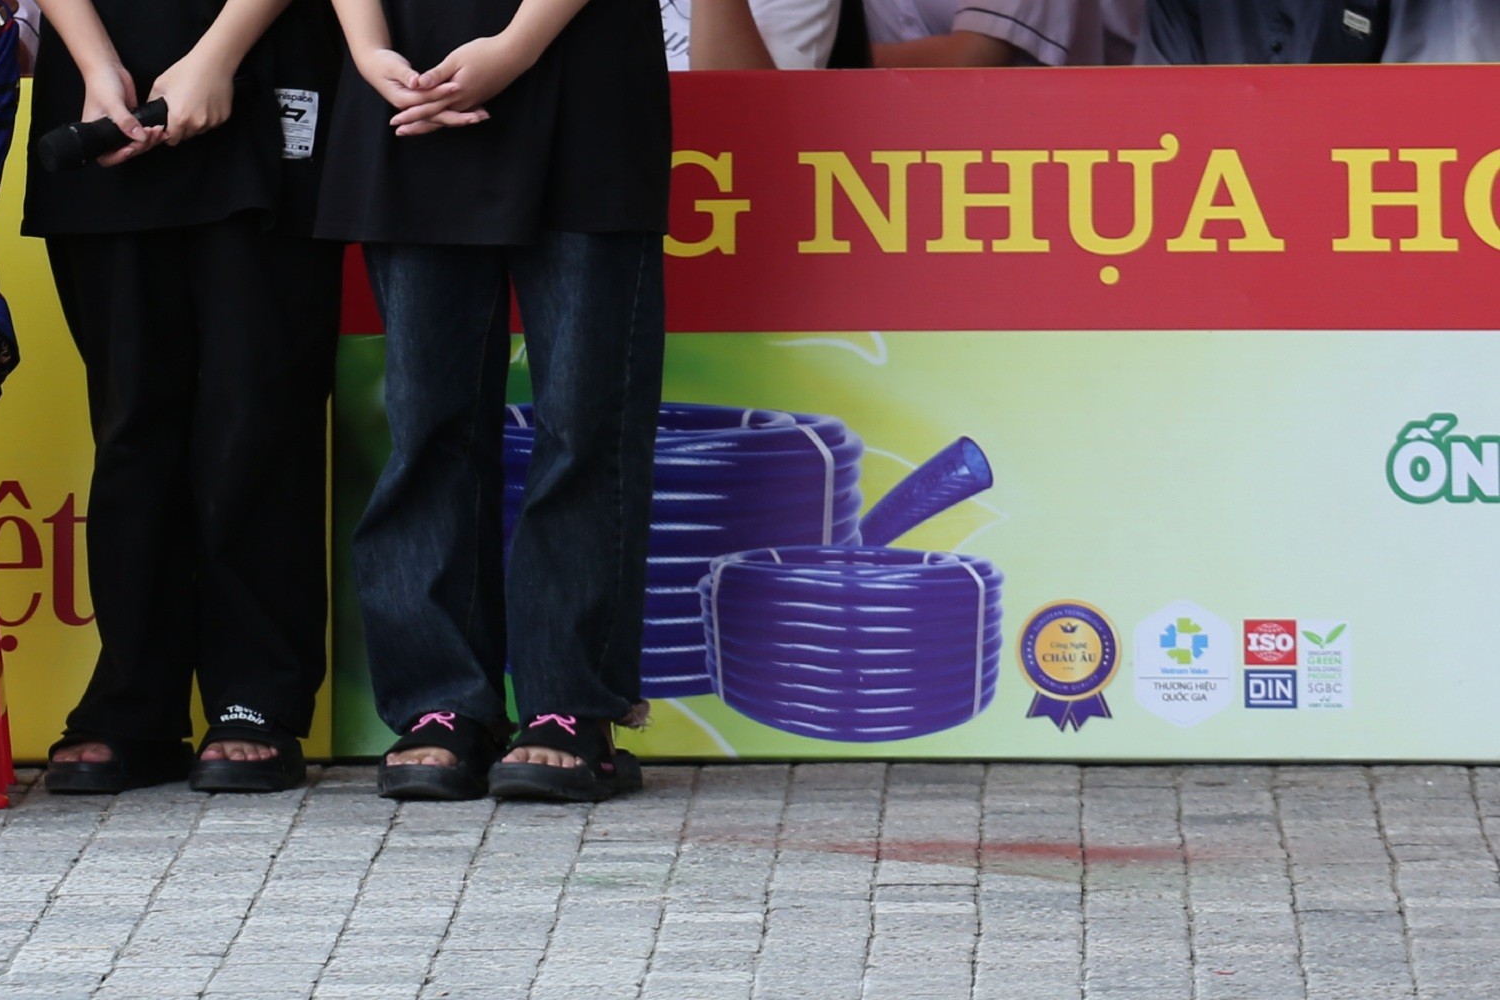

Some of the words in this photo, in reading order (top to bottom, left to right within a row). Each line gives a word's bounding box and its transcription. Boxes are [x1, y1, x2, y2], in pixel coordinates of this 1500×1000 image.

[276, 92, 313, 104] nispace
[797, 133, 1286, 285] NHỰA
[1247, 632, 1294, 652] ISO
[1041, 650, 1076, 662] CHÂU
[1080, 650, 1096, 662] ÂU
[1307, 656, 1342, 665] GREEN
[1195, 680, 1217, 692] HIỆU
[1249, 679, 1293, 699] DIN
[1307, 682, 1343, 694] SGBC
[1191, 692, 1207, 701] GIA
